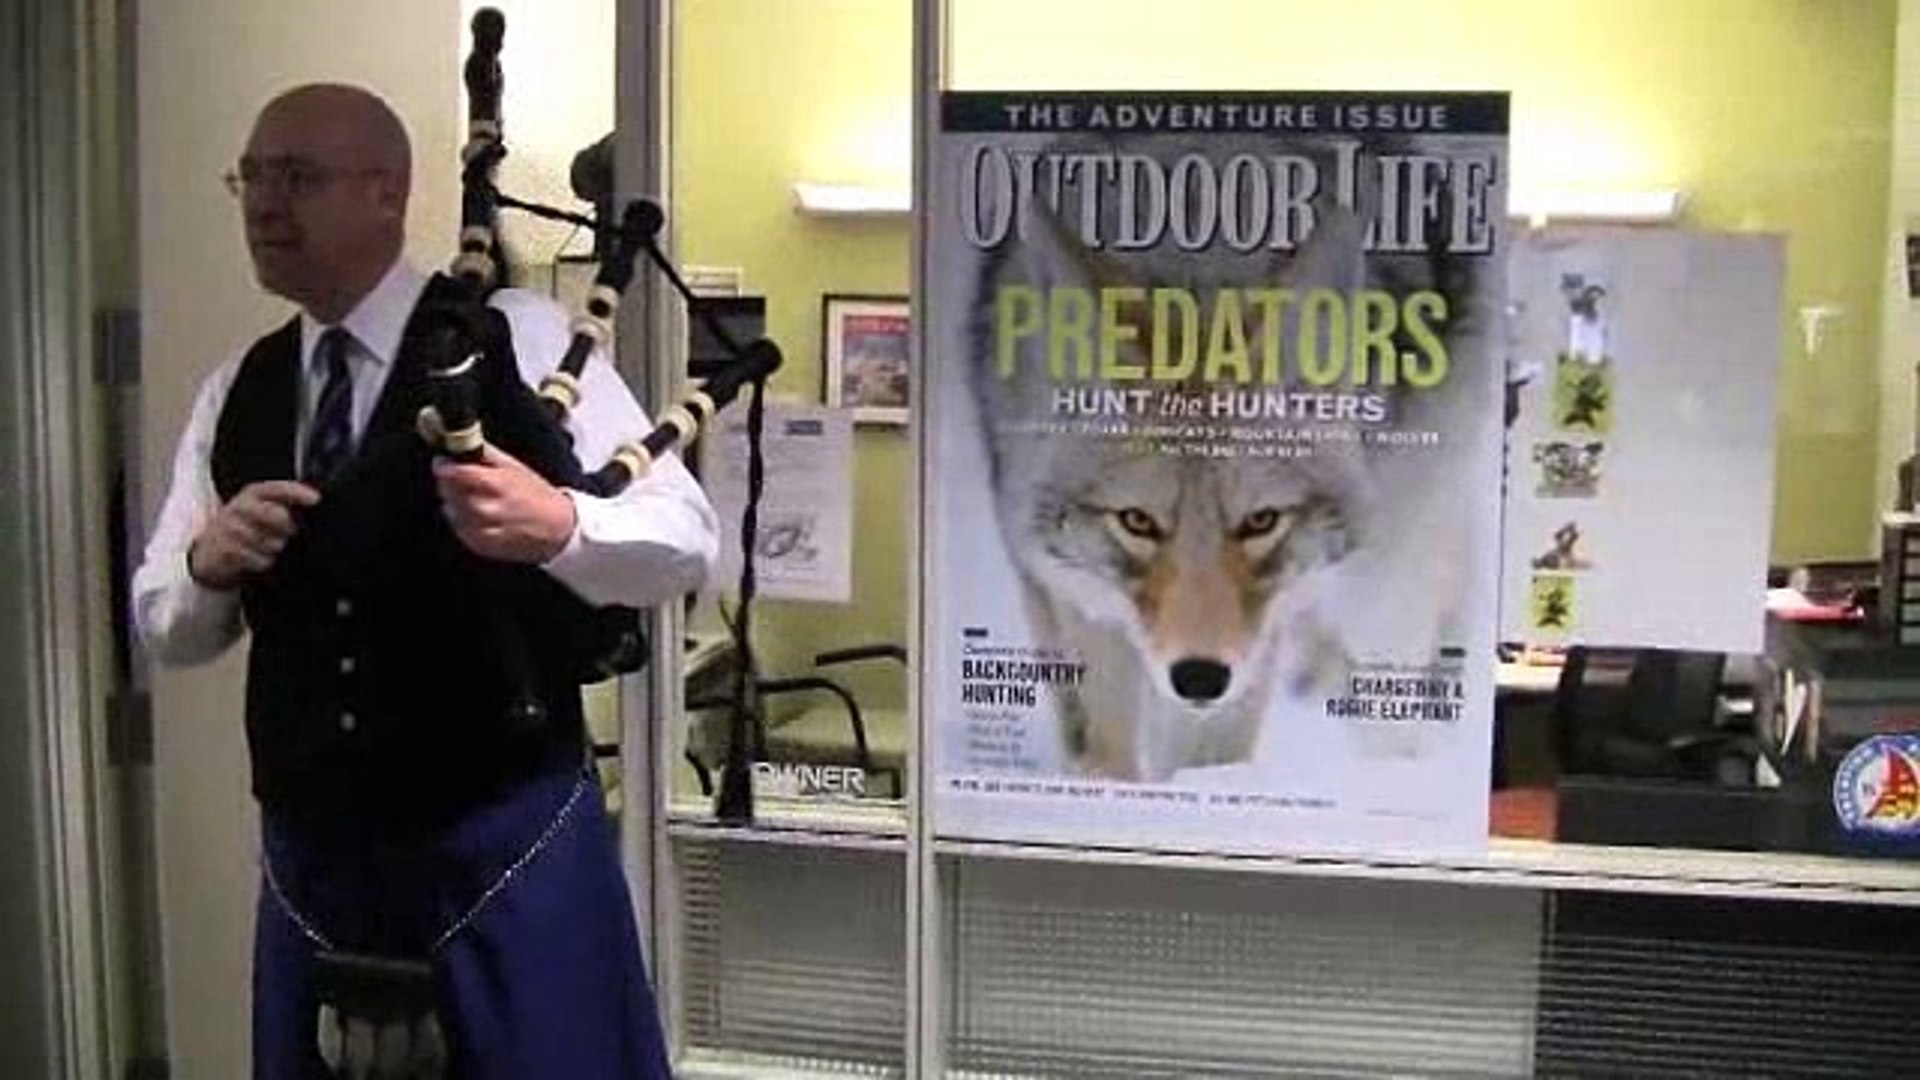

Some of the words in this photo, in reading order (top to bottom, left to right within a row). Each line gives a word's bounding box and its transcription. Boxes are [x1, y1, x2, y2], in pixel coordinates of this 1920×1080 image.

[1005, 103, 1074, 129] THE
[1087, 103, 1318, 130] ADVENTURE
[1333, 103, 1448, 130] ISSUE
[960, 143, 1319, 250] OUTDOOR
[1332, 140, 1494, 255] LIFE
[998, 286, 1449, 388] PREDATORS
[1050, 389, 1148, 416] HUNT
[1158, 390, 1200, 417] the
[1209, 393, 1386, 422] HUNTERS
[962, 659, 1086, 685] BACKCOUNTRY
[962, 683, 1037, 708] HUNTING
[1454, 681, 1463, 699] A
[1379, 701, 1461, 721] ELEPHANT
